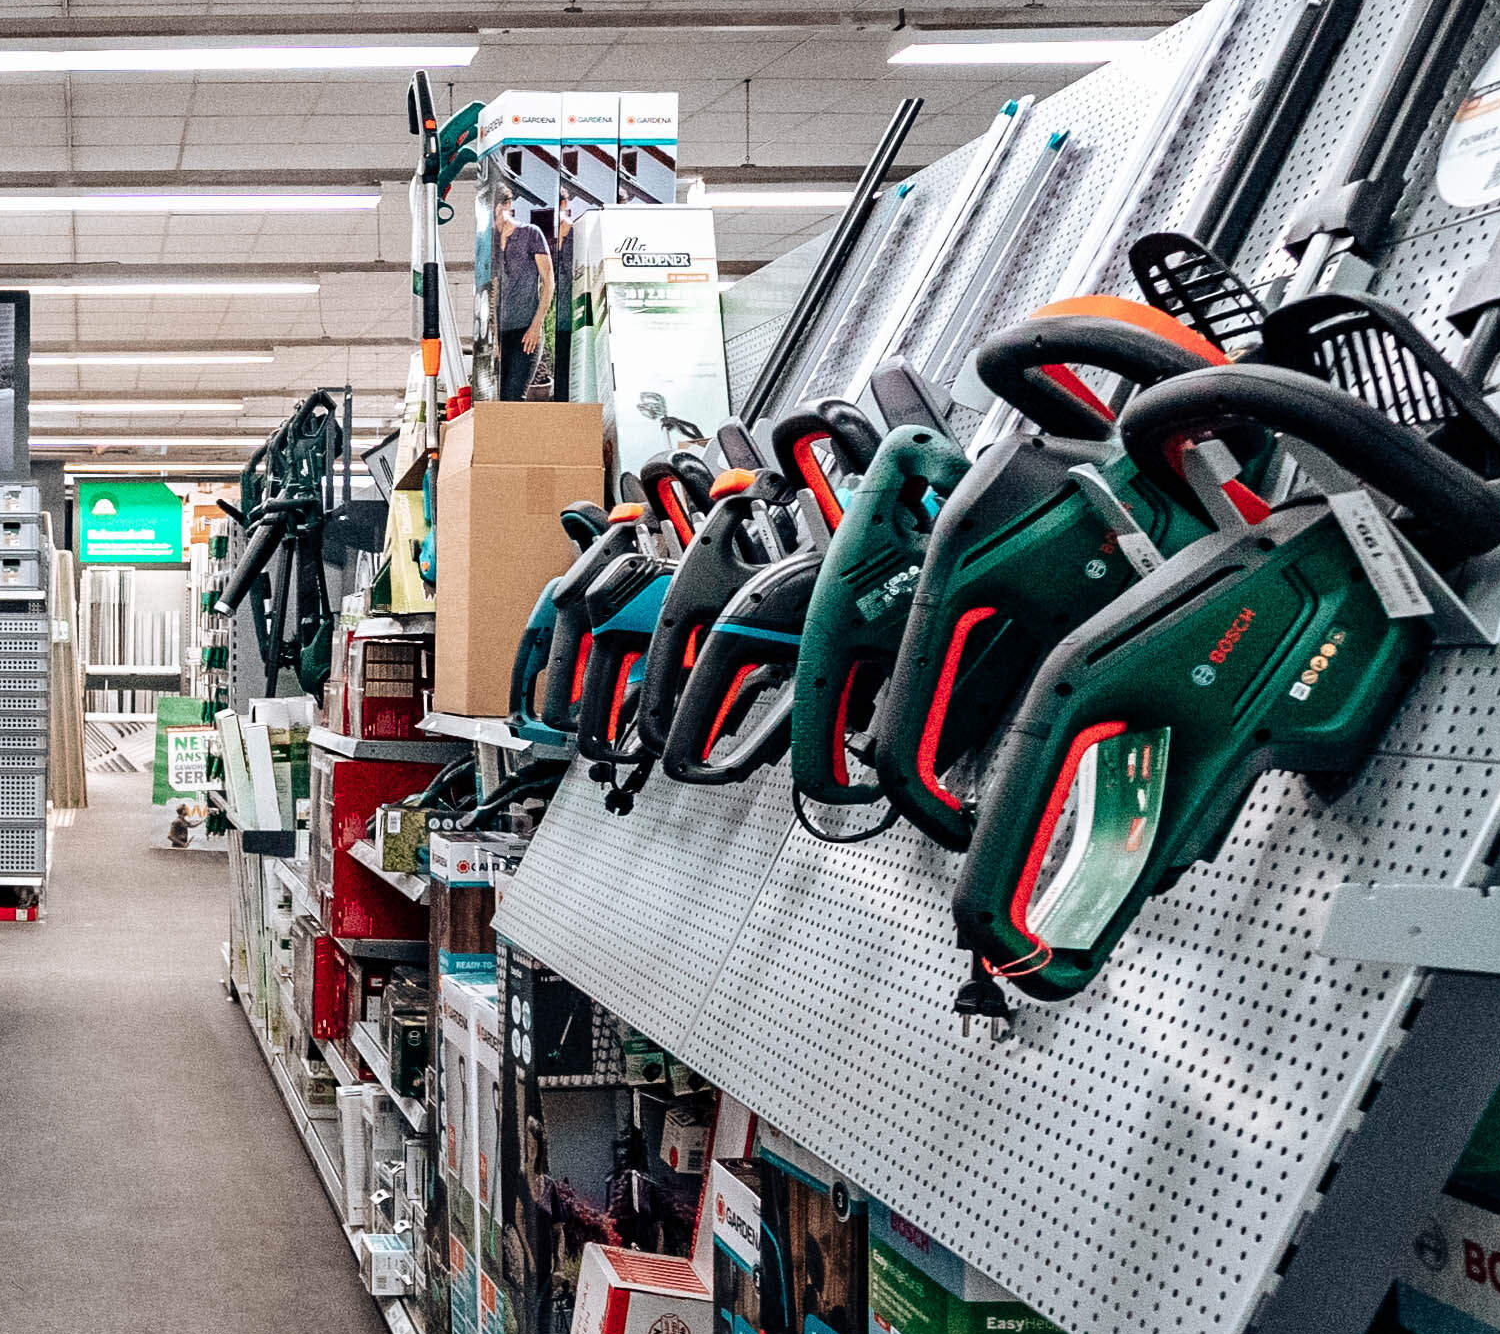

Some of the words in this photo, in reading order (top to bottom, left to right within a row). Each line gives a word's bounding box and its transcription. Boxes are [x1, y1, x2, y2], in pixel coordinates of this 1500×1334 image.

[522, 116, 556, 124] GARDENA
[578, 116, 612, 124] GARDENA
[636, 117, 671, 125] GARDENA
[615, 237, 647, 253] Mr.
[624, 255, 690, 266] GARDENER
[1209, 608, 1256, 664] BOSCH
[725, 1207, 760, 1252] GARDEN
